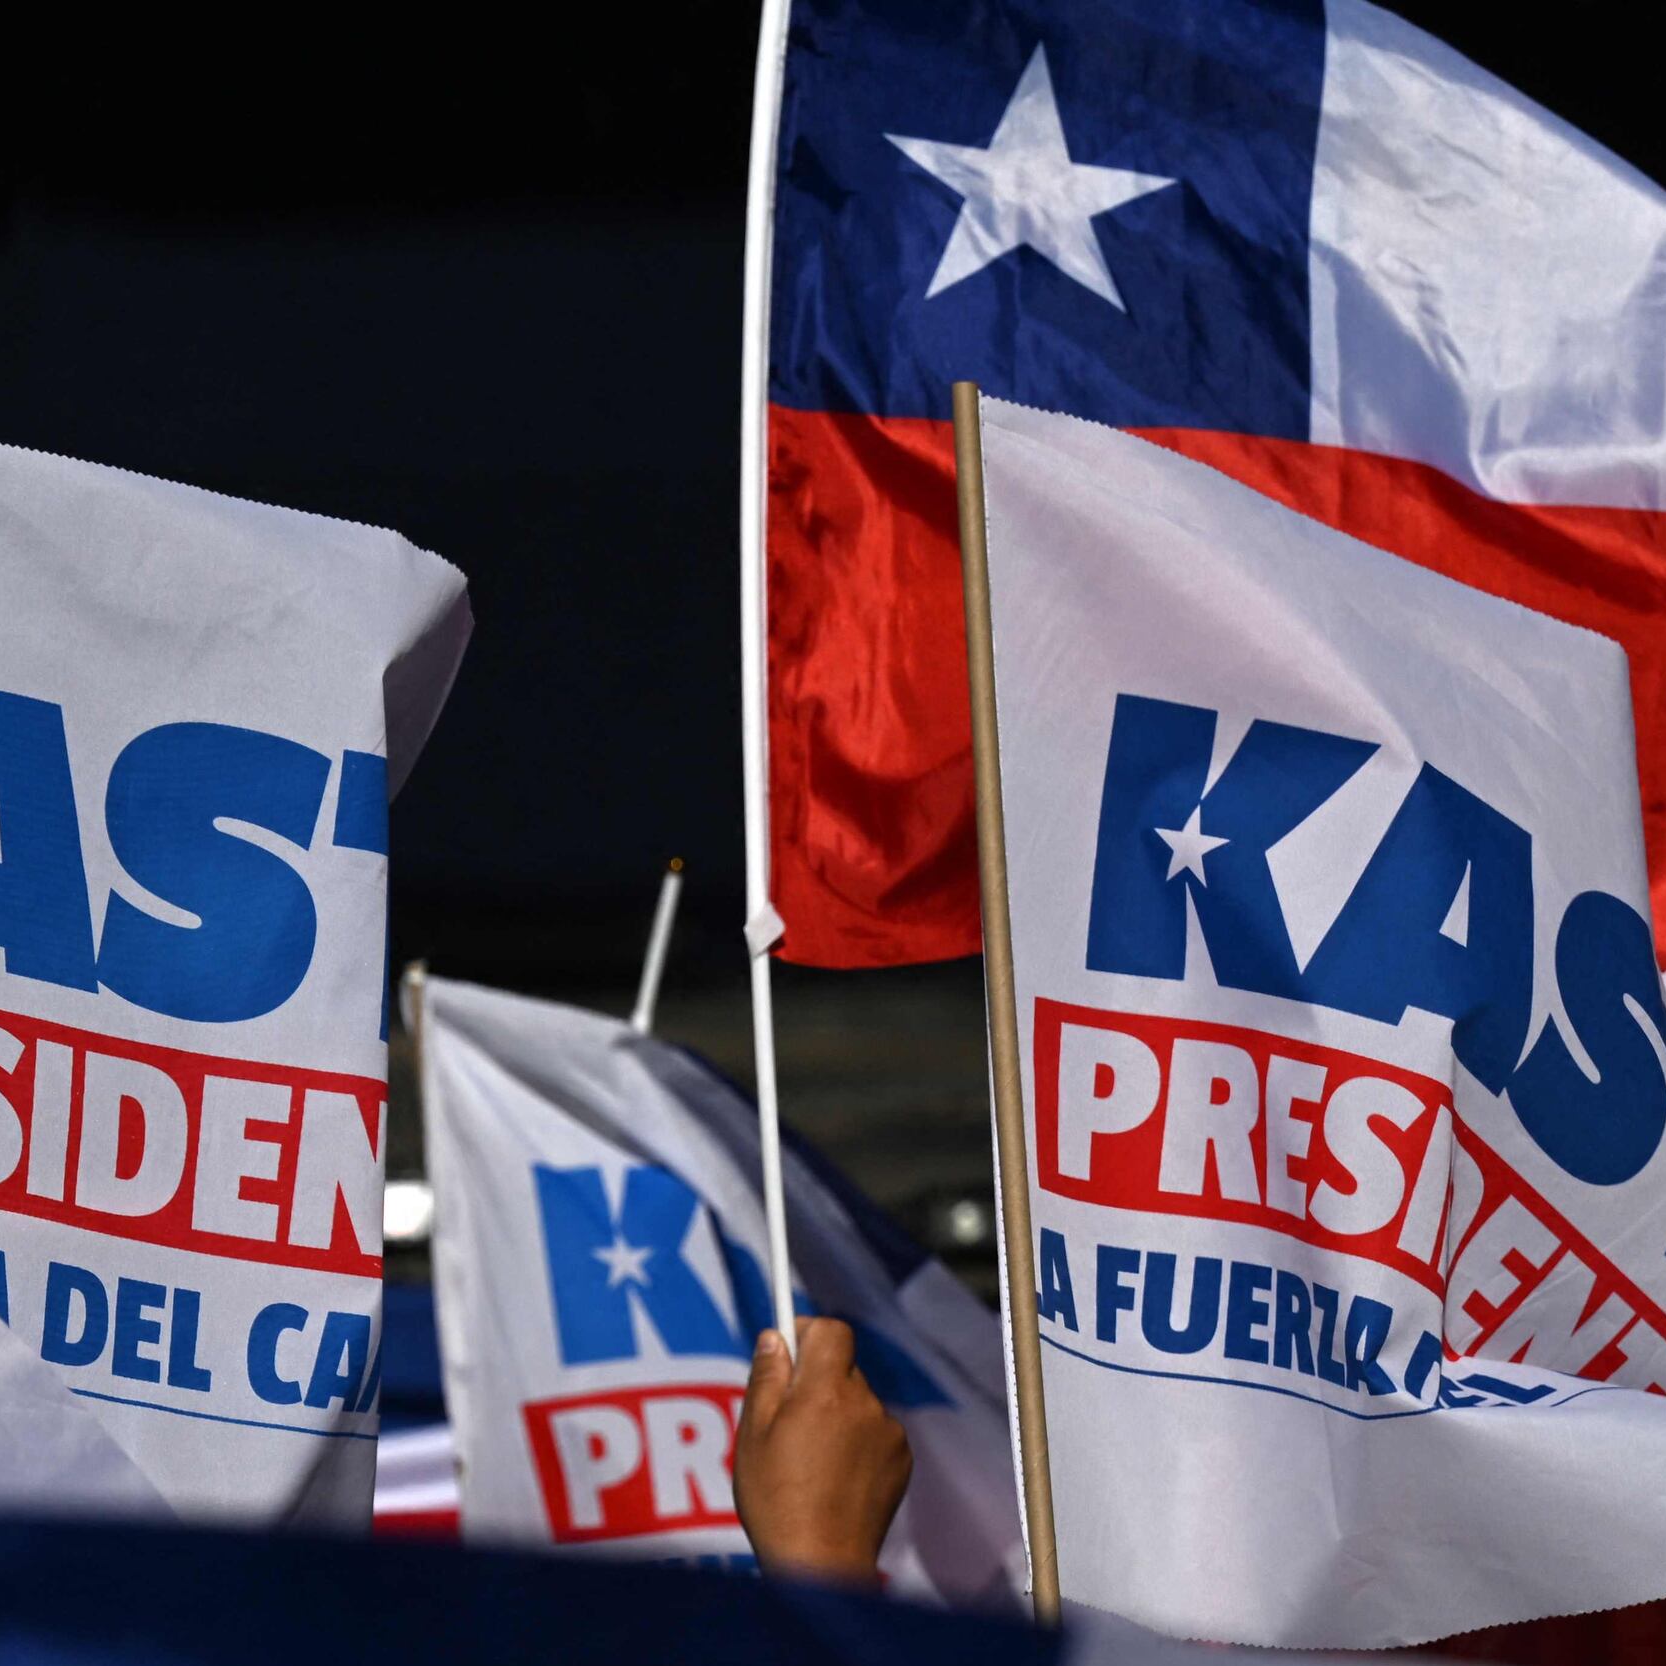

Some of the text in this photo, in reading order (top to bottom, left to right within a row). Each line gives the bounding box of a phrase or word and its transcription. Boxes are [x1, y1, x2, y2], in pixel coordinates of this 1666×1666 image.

[40, 1261, 212, 1393] DEL
[246, 1302, 383, 1416] CA
[1035, 1226, 1080, 1333] A
[1095, 1243, 1398, 1396] FUERZA
[547, 1394, 744, 1531] PR
